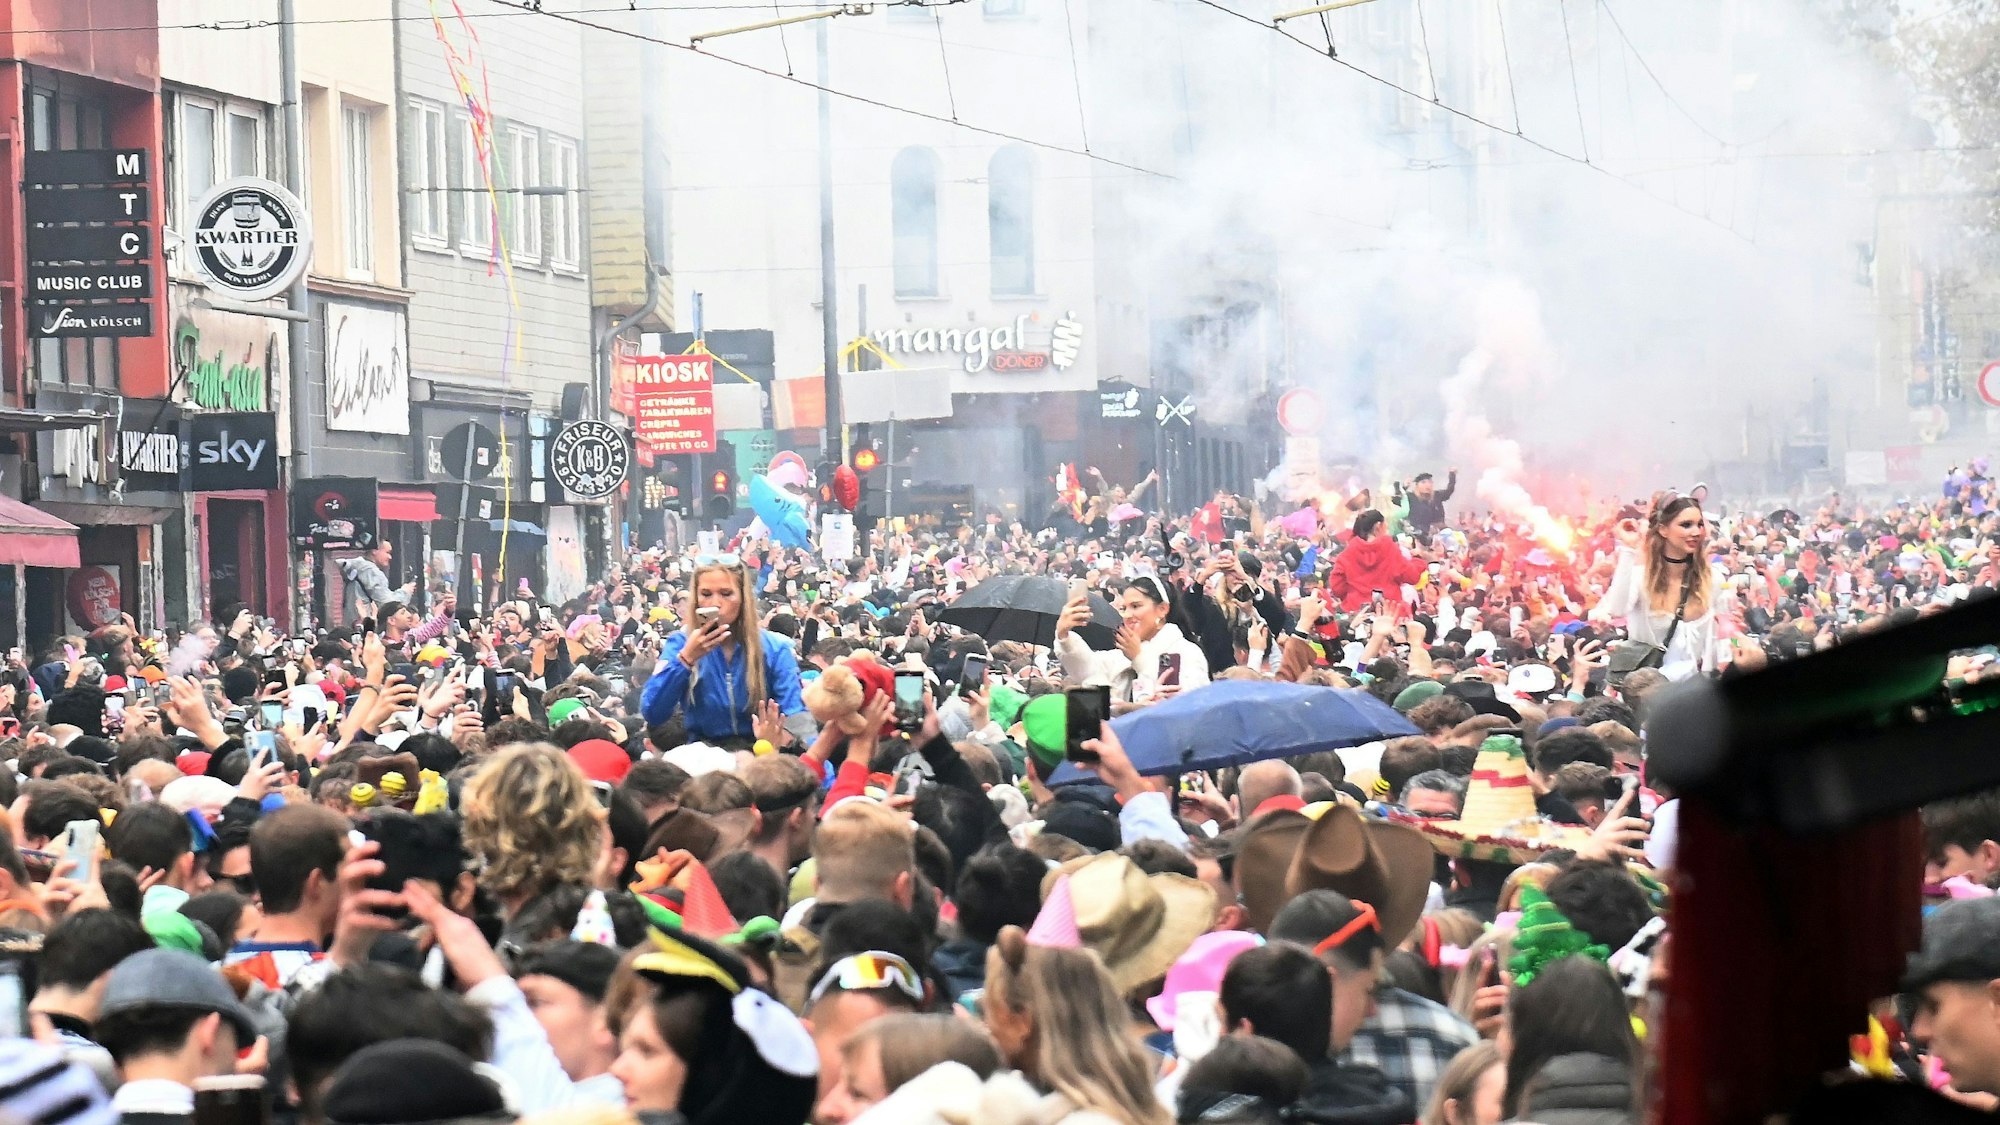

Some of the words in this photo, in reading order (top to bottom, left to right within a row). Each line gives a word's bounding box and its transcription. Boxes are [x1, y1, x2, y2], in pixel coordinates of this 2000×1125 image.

[195, 230, 299, 244] KWARTIER
[37, 275, 92, 291] MUSIC
[97, 275, 143, 290] CLUB
[90, 316, 143, 329] KÖLSCH
[874, 314, 1030, 373] mangal
[636, 361, 710, 384] KIOSK
[640, 407, 712, 417] TABAKWAREN
[557, 423, 622, 453] FRISEUR
[679, 441, 692, 449] TO
[694, 441, 709, 449] GO
[121, 430, 178, 474] KWARTIER
[199, 430, 267, 471] sky
[576, 445, 604, 473] K&B
